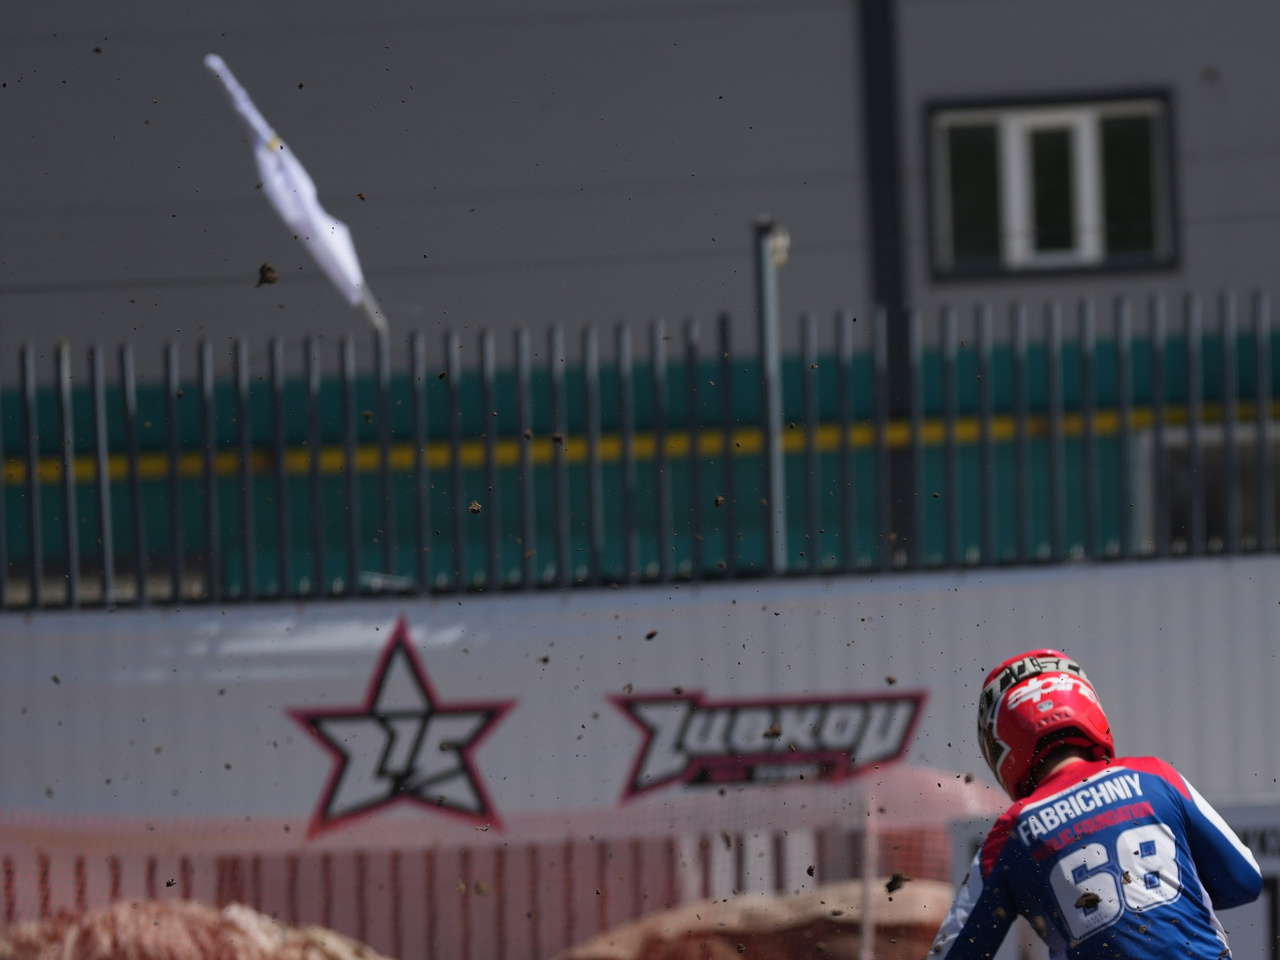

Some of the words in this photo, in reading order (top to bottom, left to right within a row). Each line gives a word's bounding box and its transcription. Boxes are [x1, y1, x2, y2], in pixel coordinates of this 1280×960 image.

[1017, 773, 1144, 847] FABRICHNIY
[1073, 801, 1155, 839] FOUNDATION
[1050, 822, 1182, 941] 68
